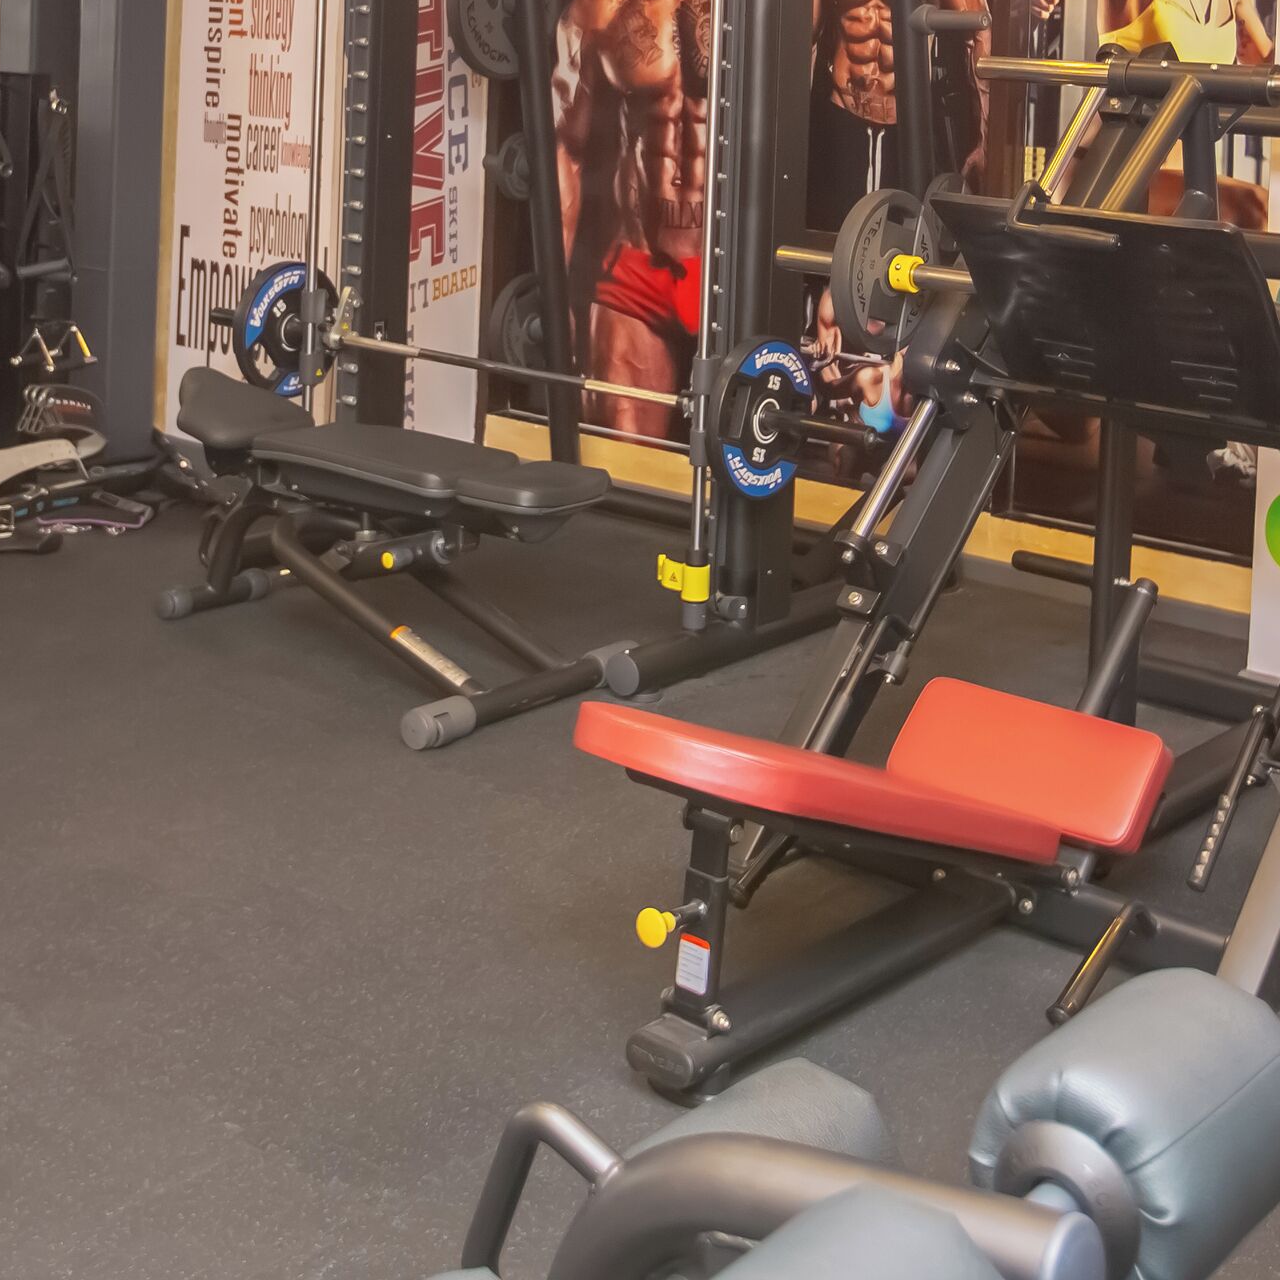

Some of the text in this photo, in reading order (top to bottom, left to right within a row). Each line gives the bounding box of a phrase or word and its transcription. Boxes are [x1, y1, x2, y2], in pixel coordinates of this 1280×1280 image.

[248, 53, 292, 131] thinking
[245, 123, 281, 173] career
[222, 113, 245, 259] motivate
[448, 185, 458, 264] SKIP
[432, 265, 477, 301] BOARD
[273, 300, 287, 318] 15
[767, 375, 781, 391] 15
[752, 447, 766, 463] 15
